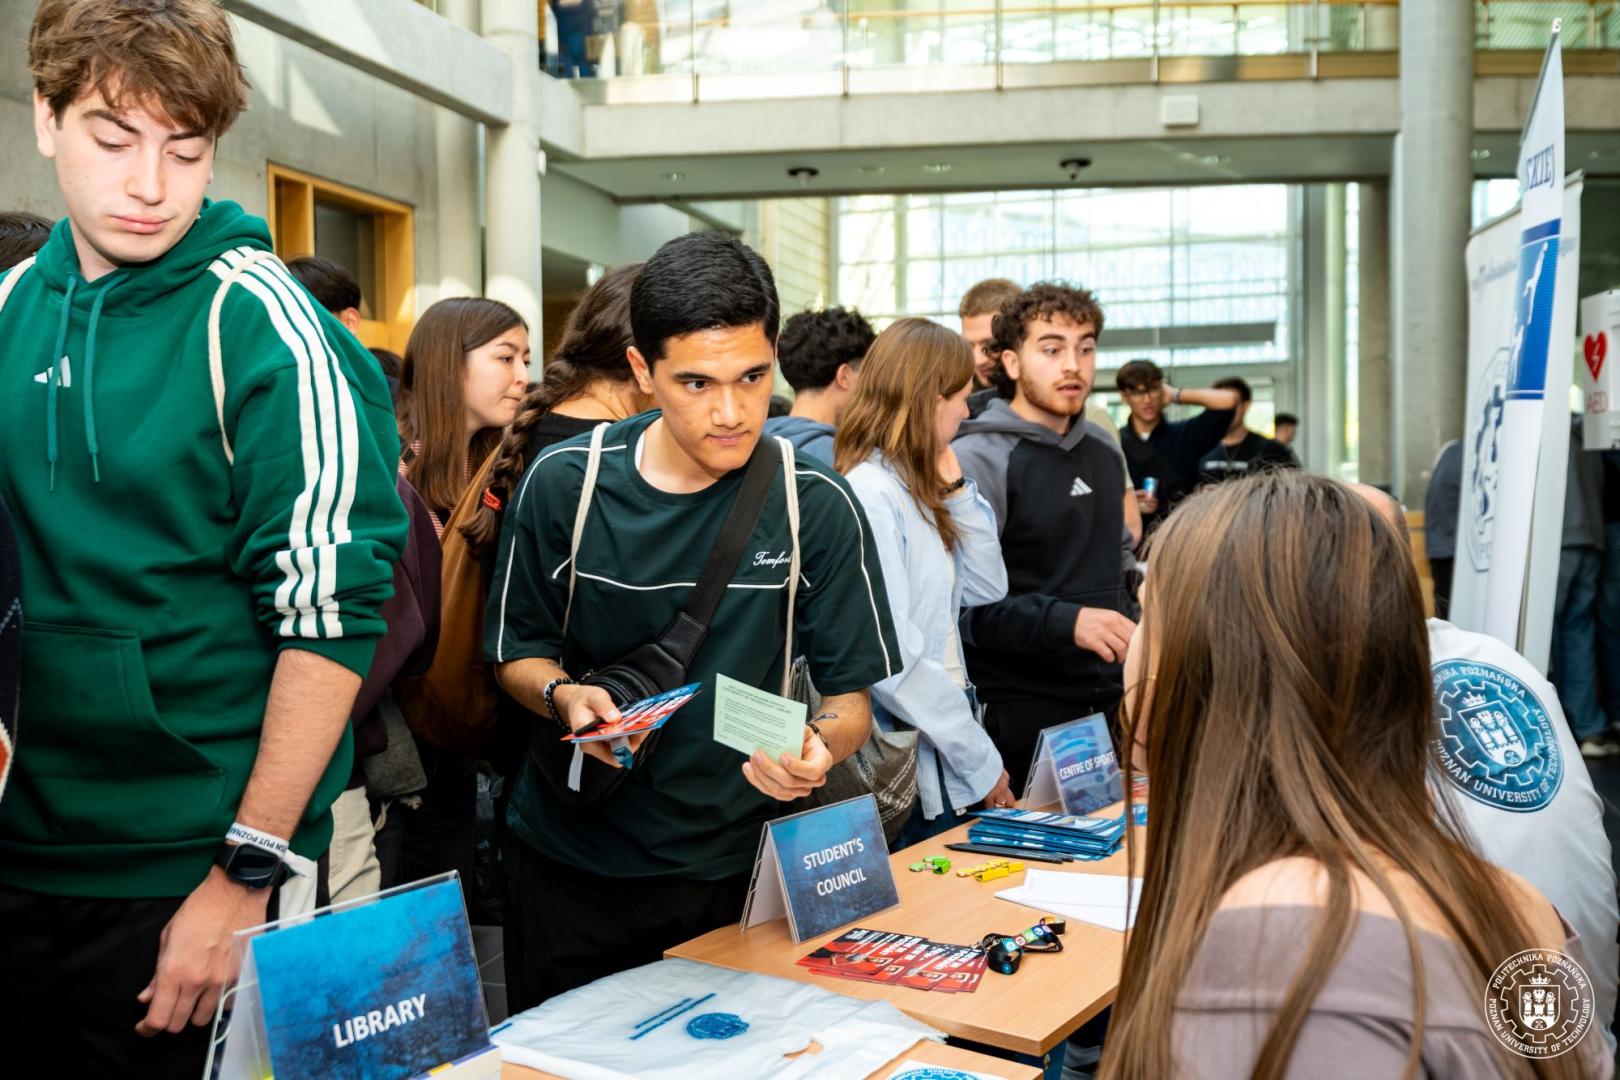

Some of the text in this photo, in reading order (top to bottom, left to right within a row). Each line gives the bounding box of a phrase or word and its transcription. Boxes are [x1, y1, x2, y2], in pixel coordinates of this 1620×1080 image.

[1532, 708, 1558, 780] TECHNOLOGY
[1059, 751, 1116, 780] CENTRE OF SPORT
[1474, 780, 1542, 803] UNIVERSITY
[1540, 778, 1551, 793] OF
[258, 838, 276, 849] PUT
[803, 837, 865, 870] STUDENT'S
[817, 867, 867, 896] COUNCIL
[333, 993, 426, 1049] LIBRARY
